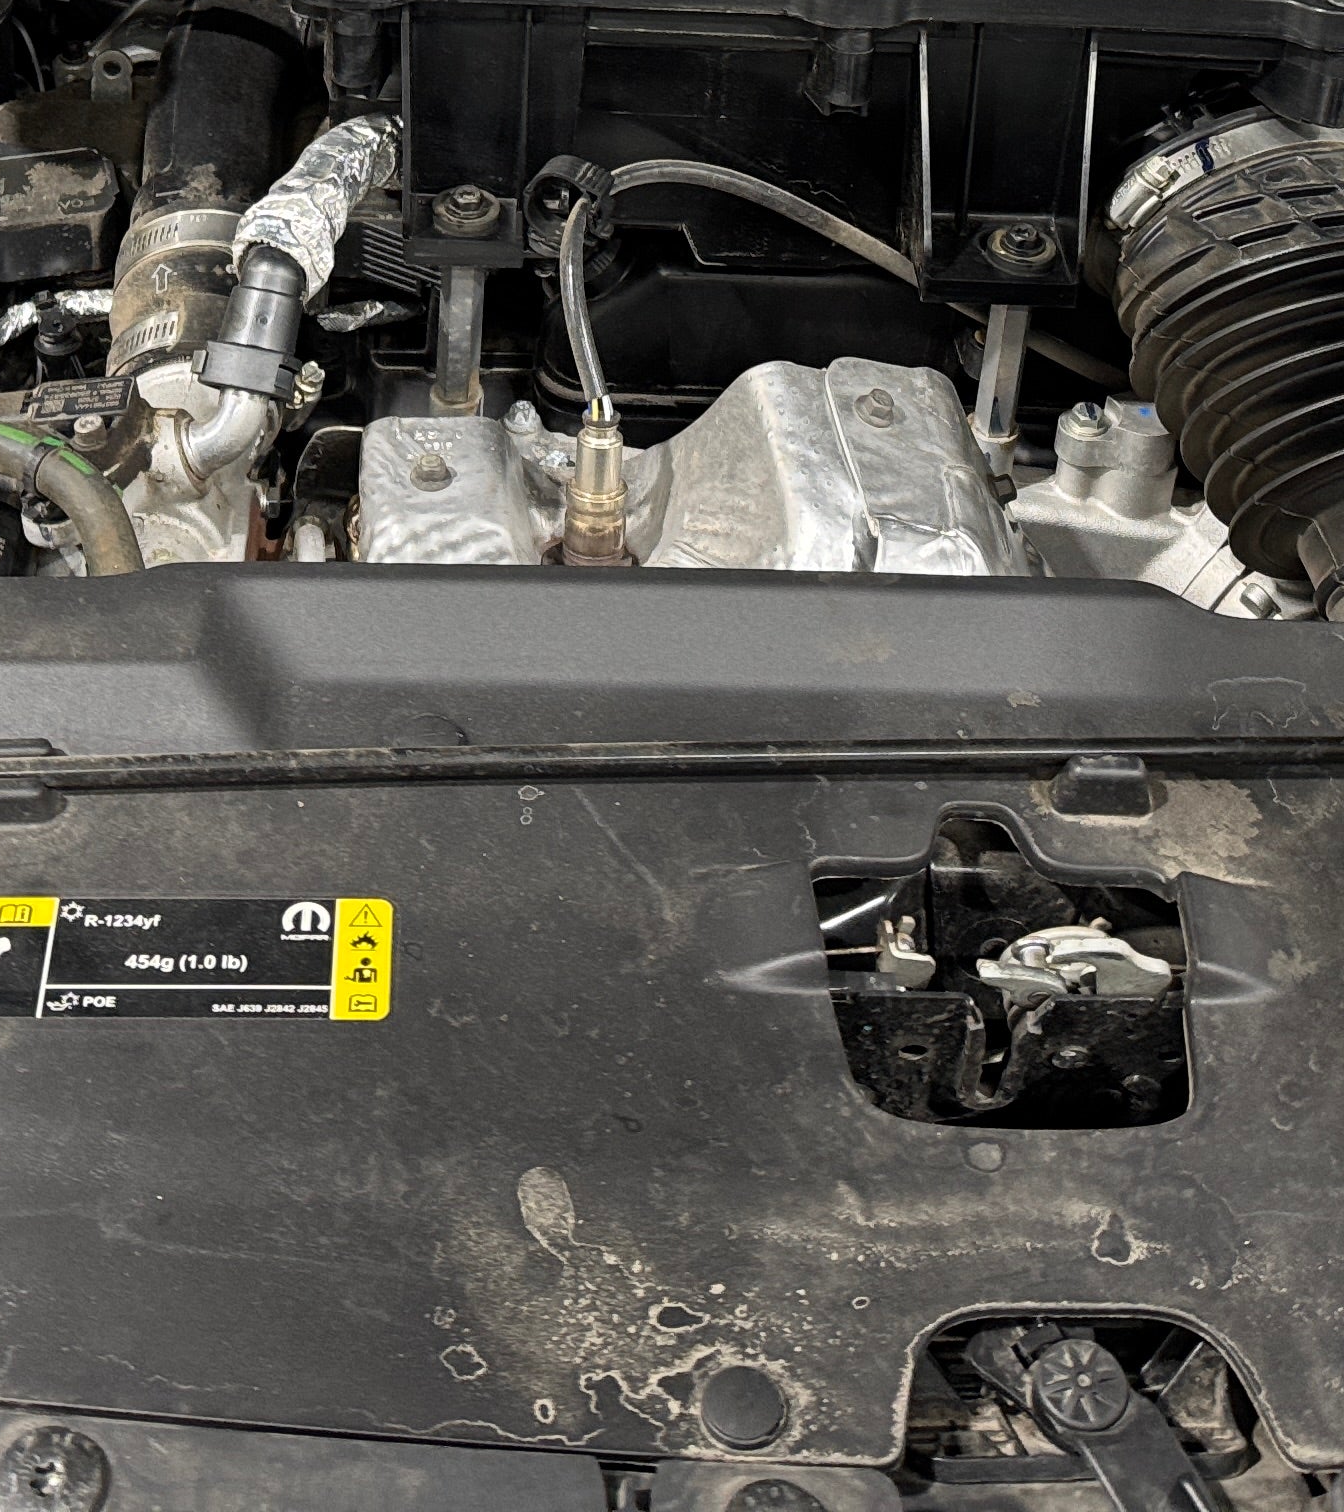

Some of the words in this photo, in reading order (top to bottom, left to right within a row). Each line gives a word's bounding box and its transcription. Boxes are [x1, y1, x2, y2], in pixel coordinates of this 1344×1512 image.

[83, 913, 161, 930] R-1234yf
[124, 953, 174, 973] 454g
[179, 953, 217, 973] (1.0
[221, 953, 249, 973] lb)
[82, 995, 118, 1009] POE
[211, 1003, 236, 1013] SAE
[236, 1003, 263, 1013] J639
